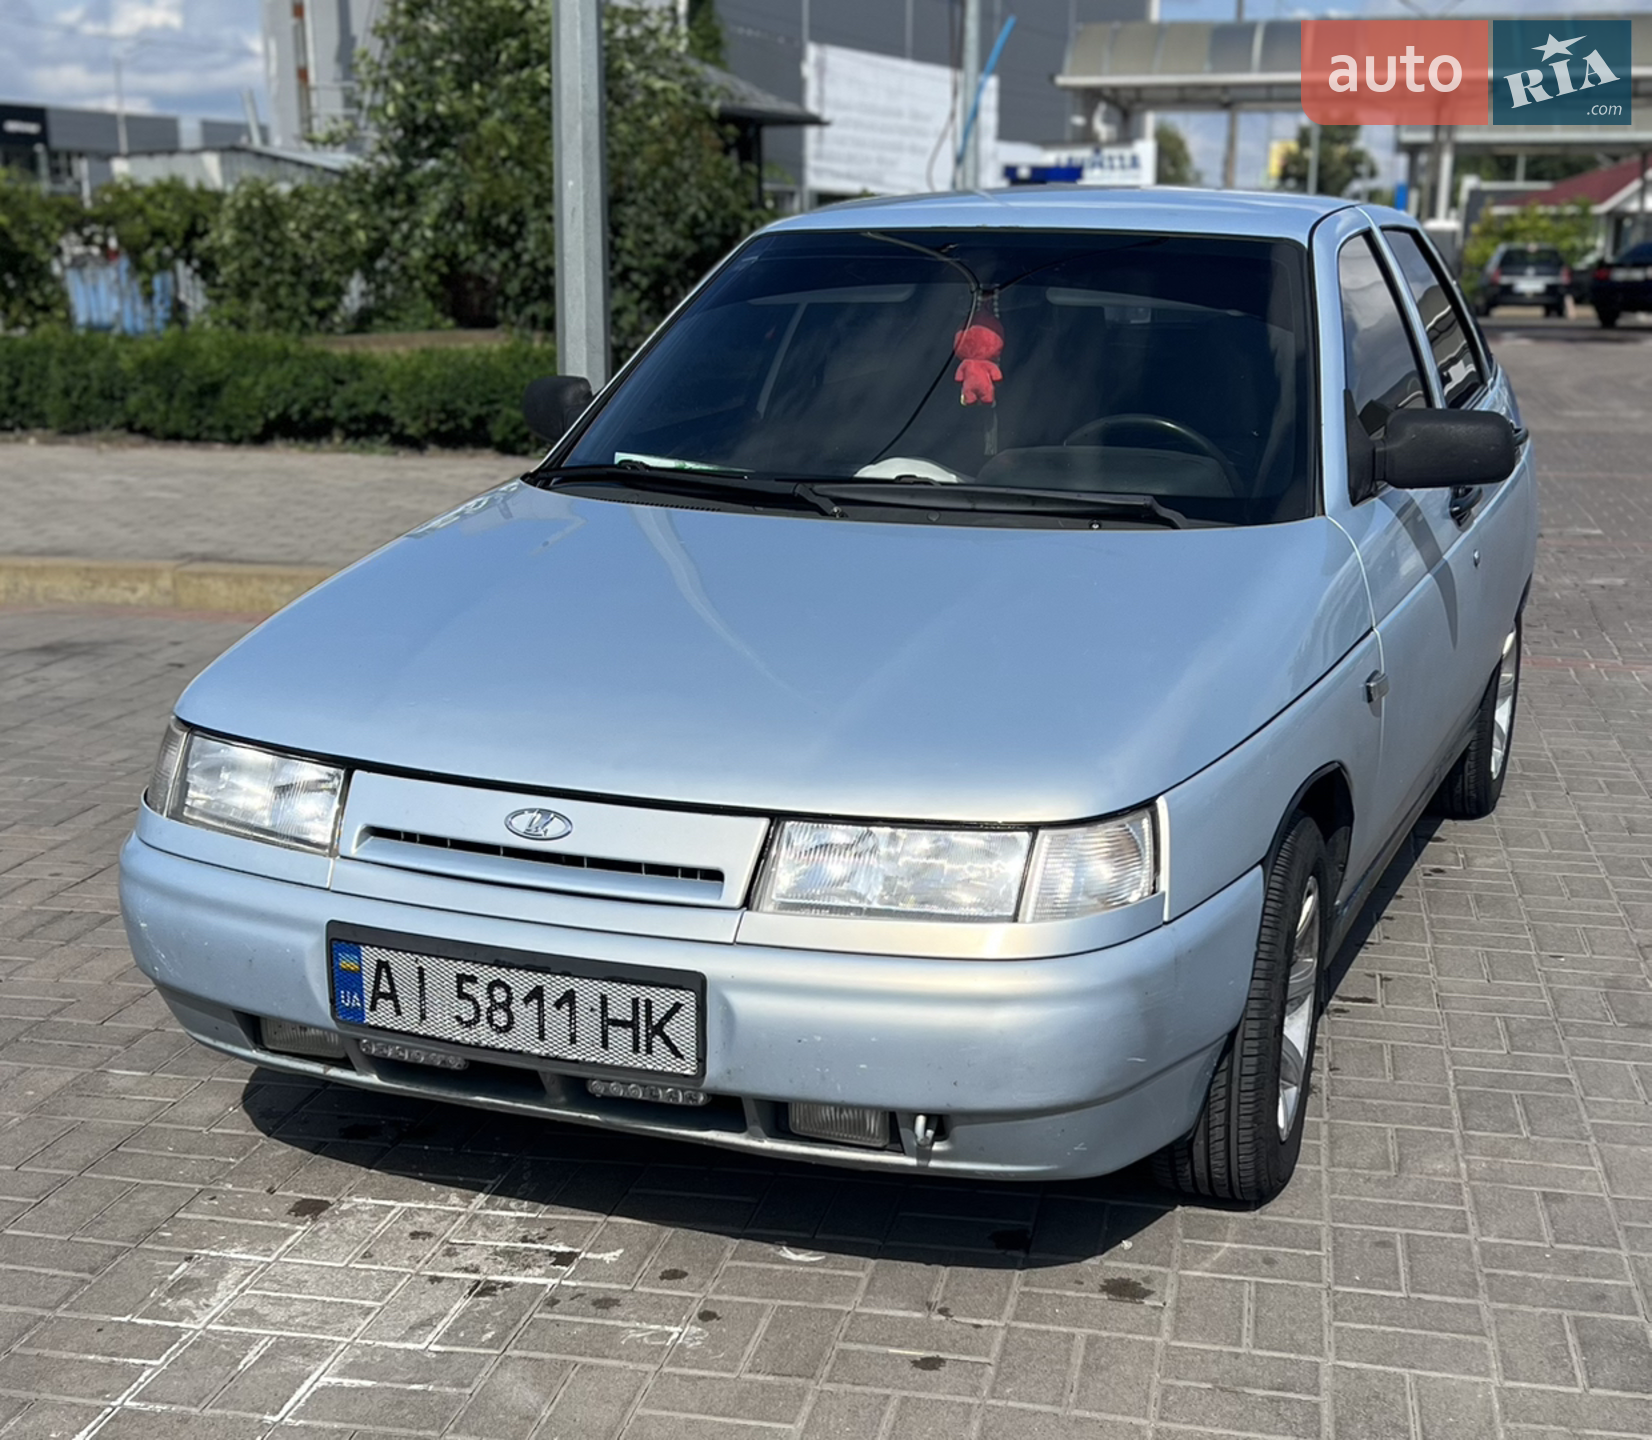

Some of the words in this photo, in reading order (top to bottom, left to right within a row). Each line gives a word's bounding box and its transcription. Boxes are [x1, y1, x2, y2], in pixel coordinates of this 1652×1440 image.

[339, 990, 362, 1008] UA
[369, 959, 427, 1021] AI
[455, 973, 578, 1045] 5811
[601, 995, 685, 1060] HK
